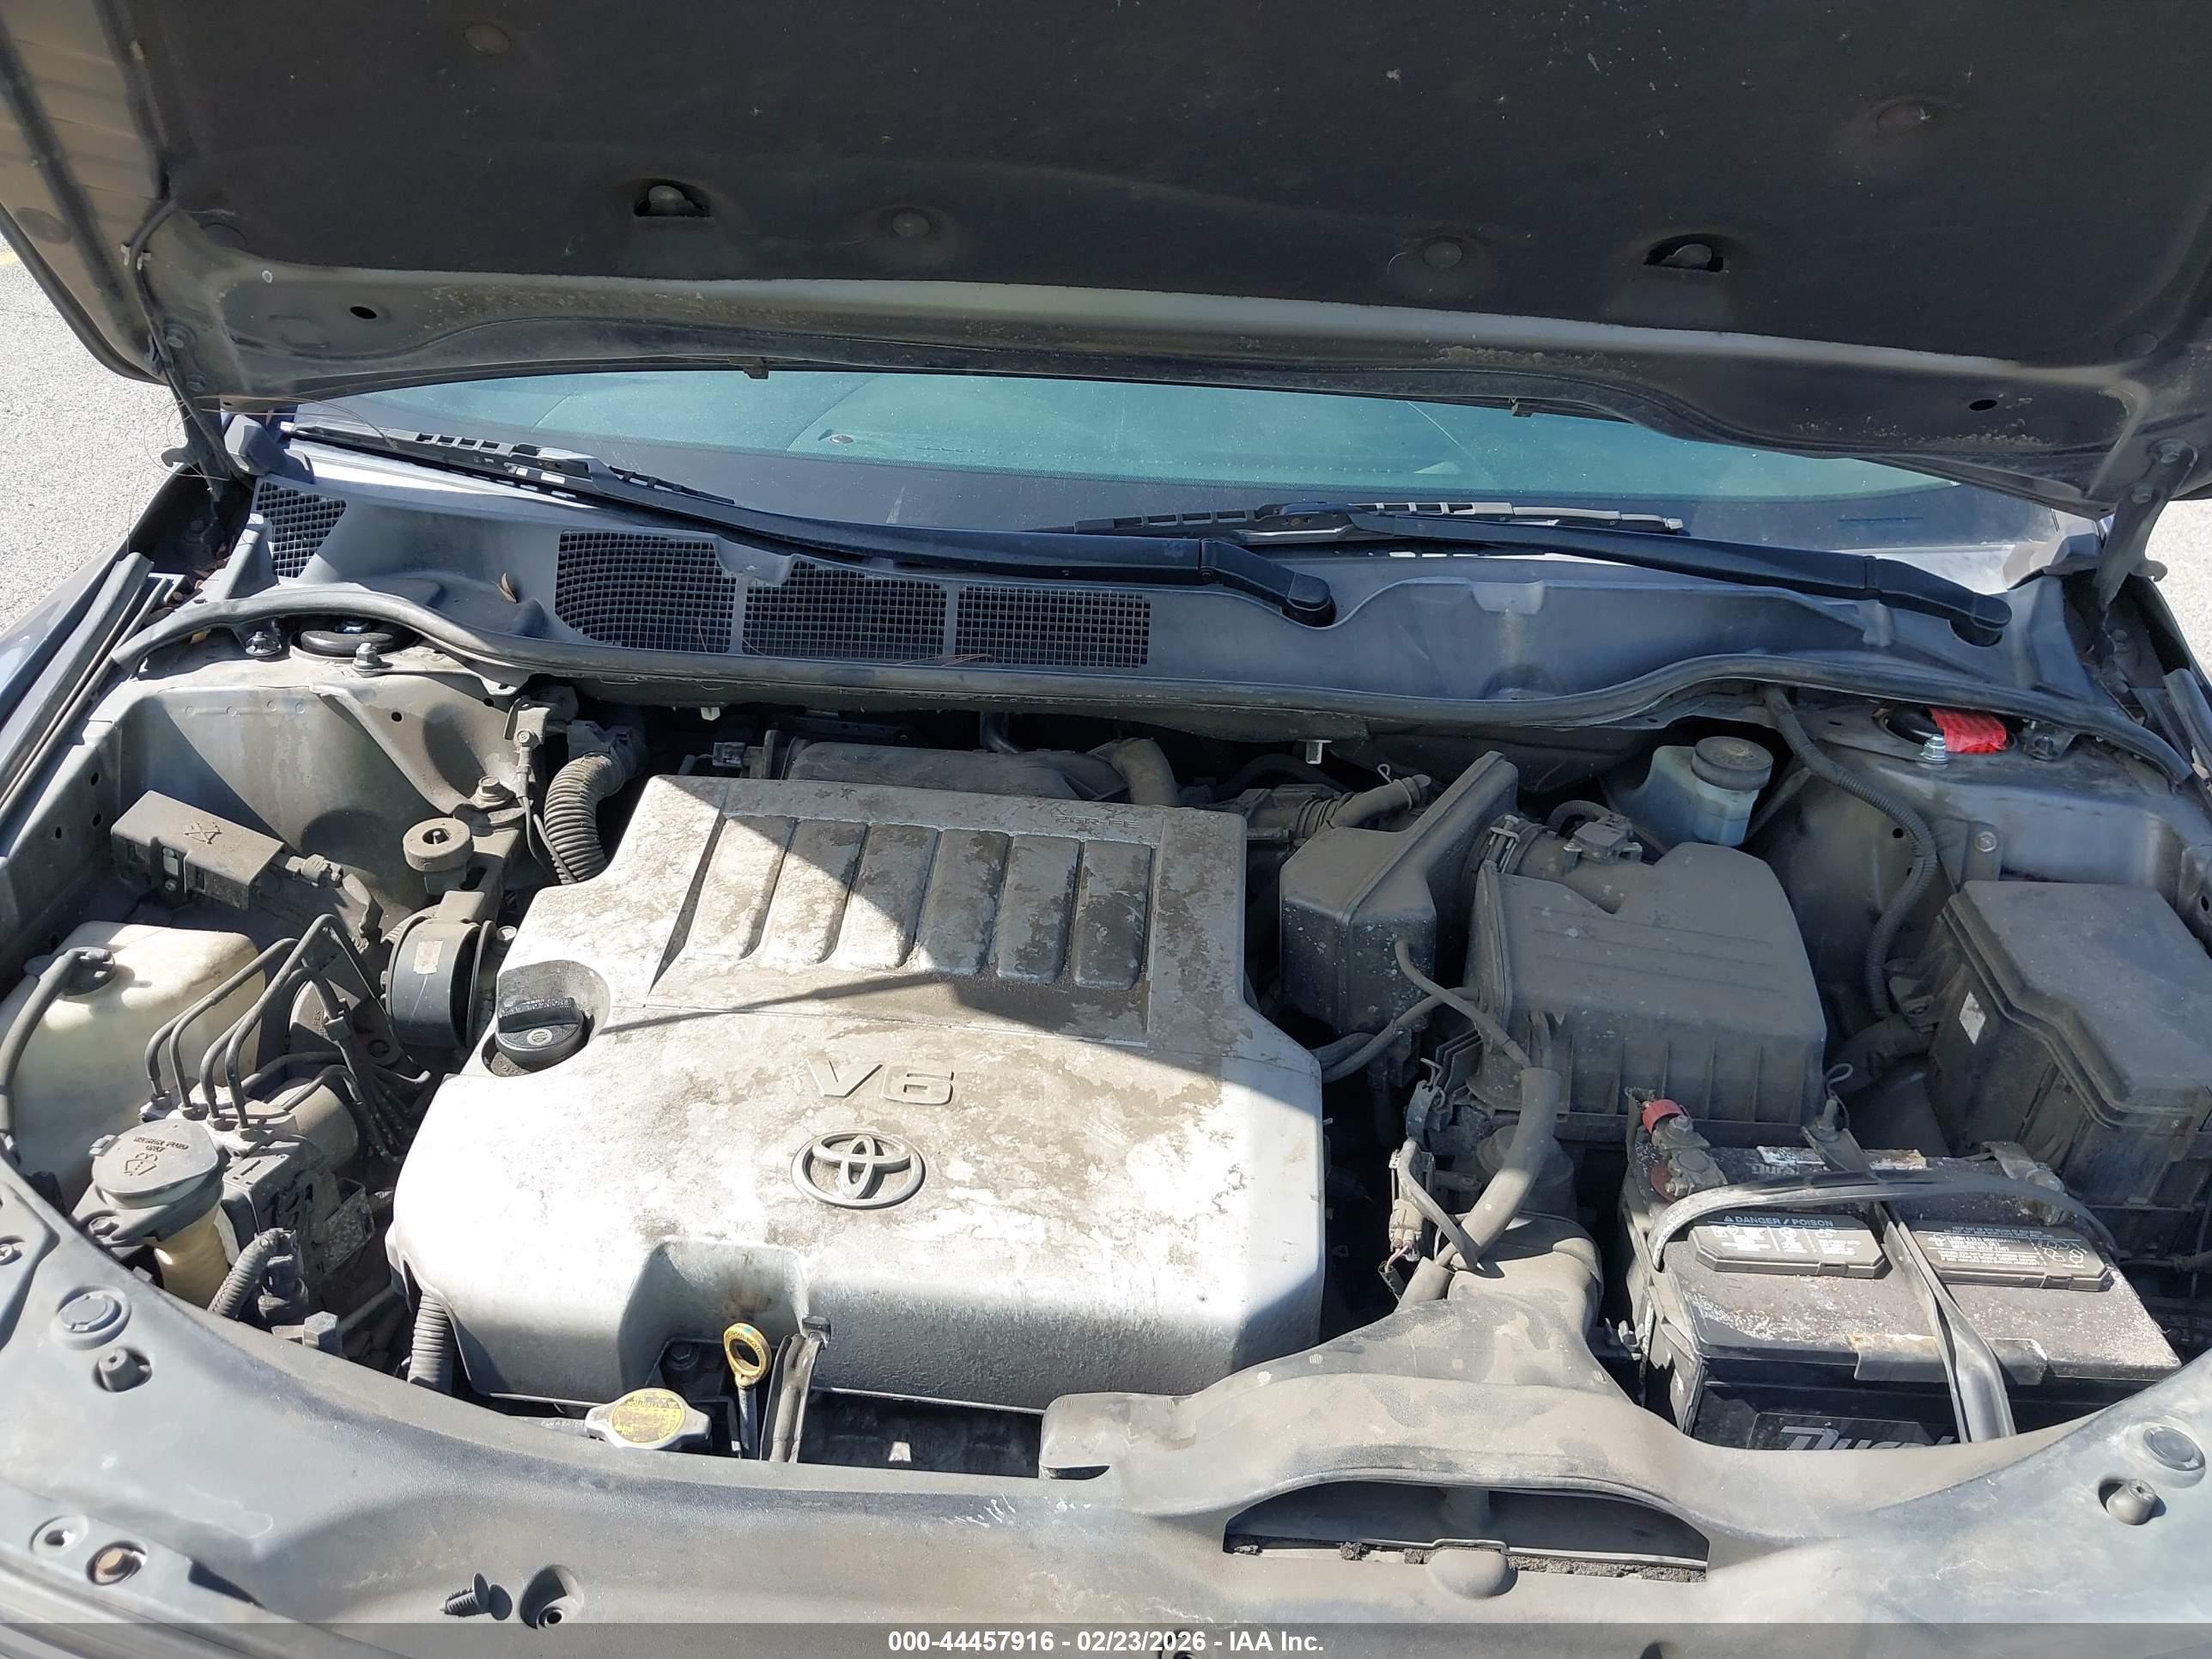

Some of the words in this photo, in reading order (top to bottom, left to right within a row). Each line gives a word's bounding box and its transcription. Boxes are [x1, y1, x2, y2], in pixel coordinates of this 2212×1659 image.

[806, 1058, 955, 1105] V6
[1735, 1216, 1781, 1225] DANGER
[1792, 1218, 1834, 1227] POISON
